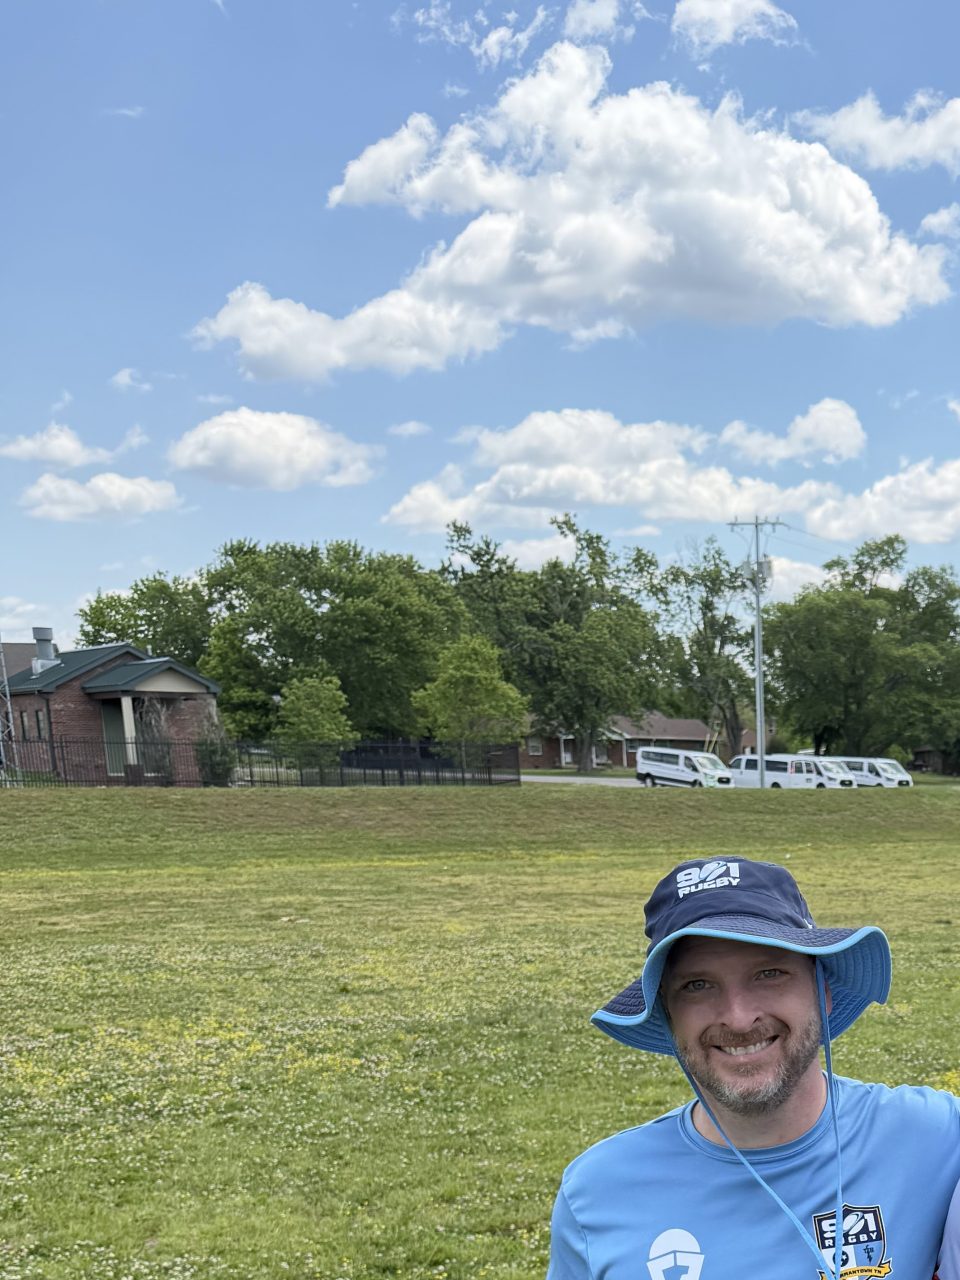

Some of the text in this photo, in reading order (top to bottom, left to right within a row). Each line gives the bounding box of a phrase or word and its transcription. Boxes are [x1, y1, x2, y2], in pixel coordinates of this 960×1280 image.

[676, 861, 740, 888] 901
[677, 877, 740, 898] RUGBY
[824, 1232, 878, 1247] RGBY
